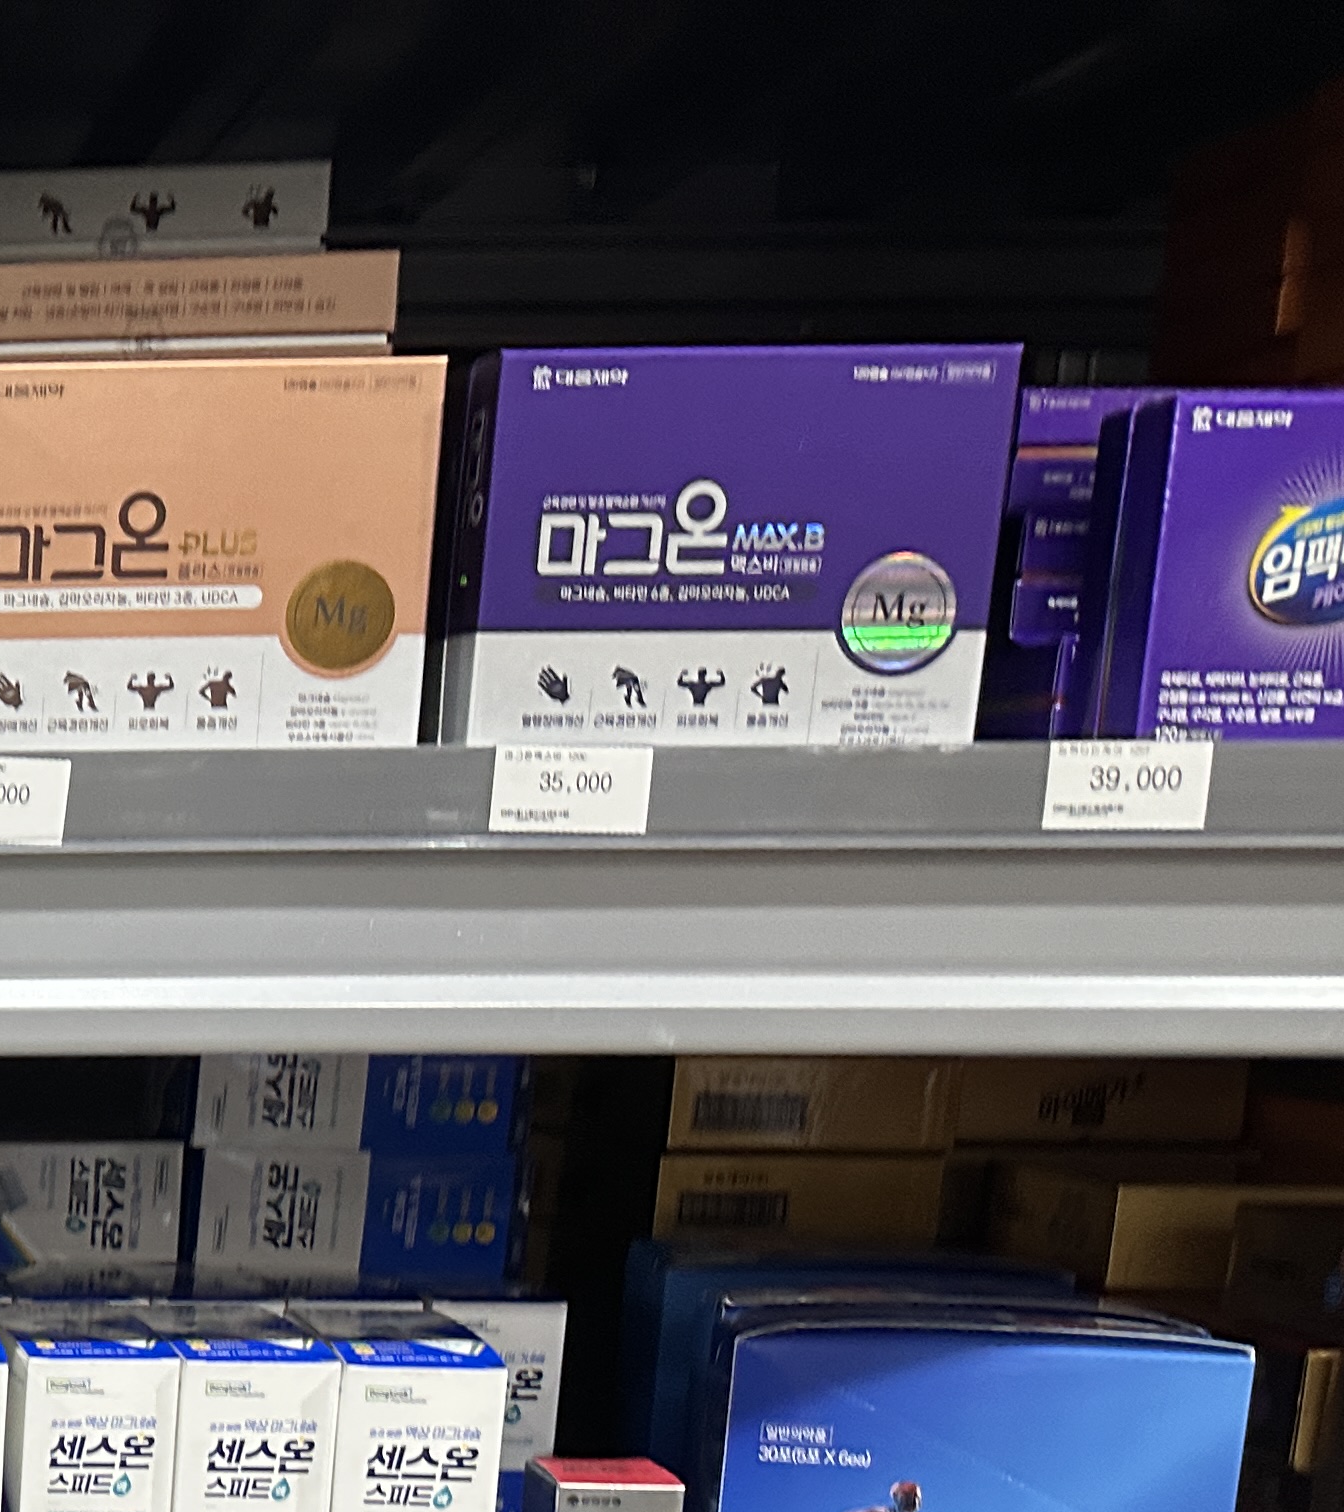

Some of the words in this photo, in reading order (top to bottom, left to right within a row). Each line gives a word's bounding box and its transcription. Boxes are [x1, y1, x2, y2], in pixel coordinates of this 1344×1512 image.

[178, 530, 258, 556] PLUS
[536, 478, 729, 578] 마그온
[731, 522, 826, 552] MAX.B
[1263, 530, 1344, 604] 임팩
[313, 597, 372, 635] Mg
[871, 592, 928, 630] Mg
[538, 770, 614, 795] 35,000
[1089, 764, 1184, 793] 39,000
[48, 1431, 156, 1471] 센스온
[207, 1436, 316, 1476] 센스온
[366, 1442, 480, 1484] 센스온
[47, 1472, 113, 1496] 스피드
[203, 1477, 271, 1500] 스피드
[362, 1484, 433, 1509] 스피드
